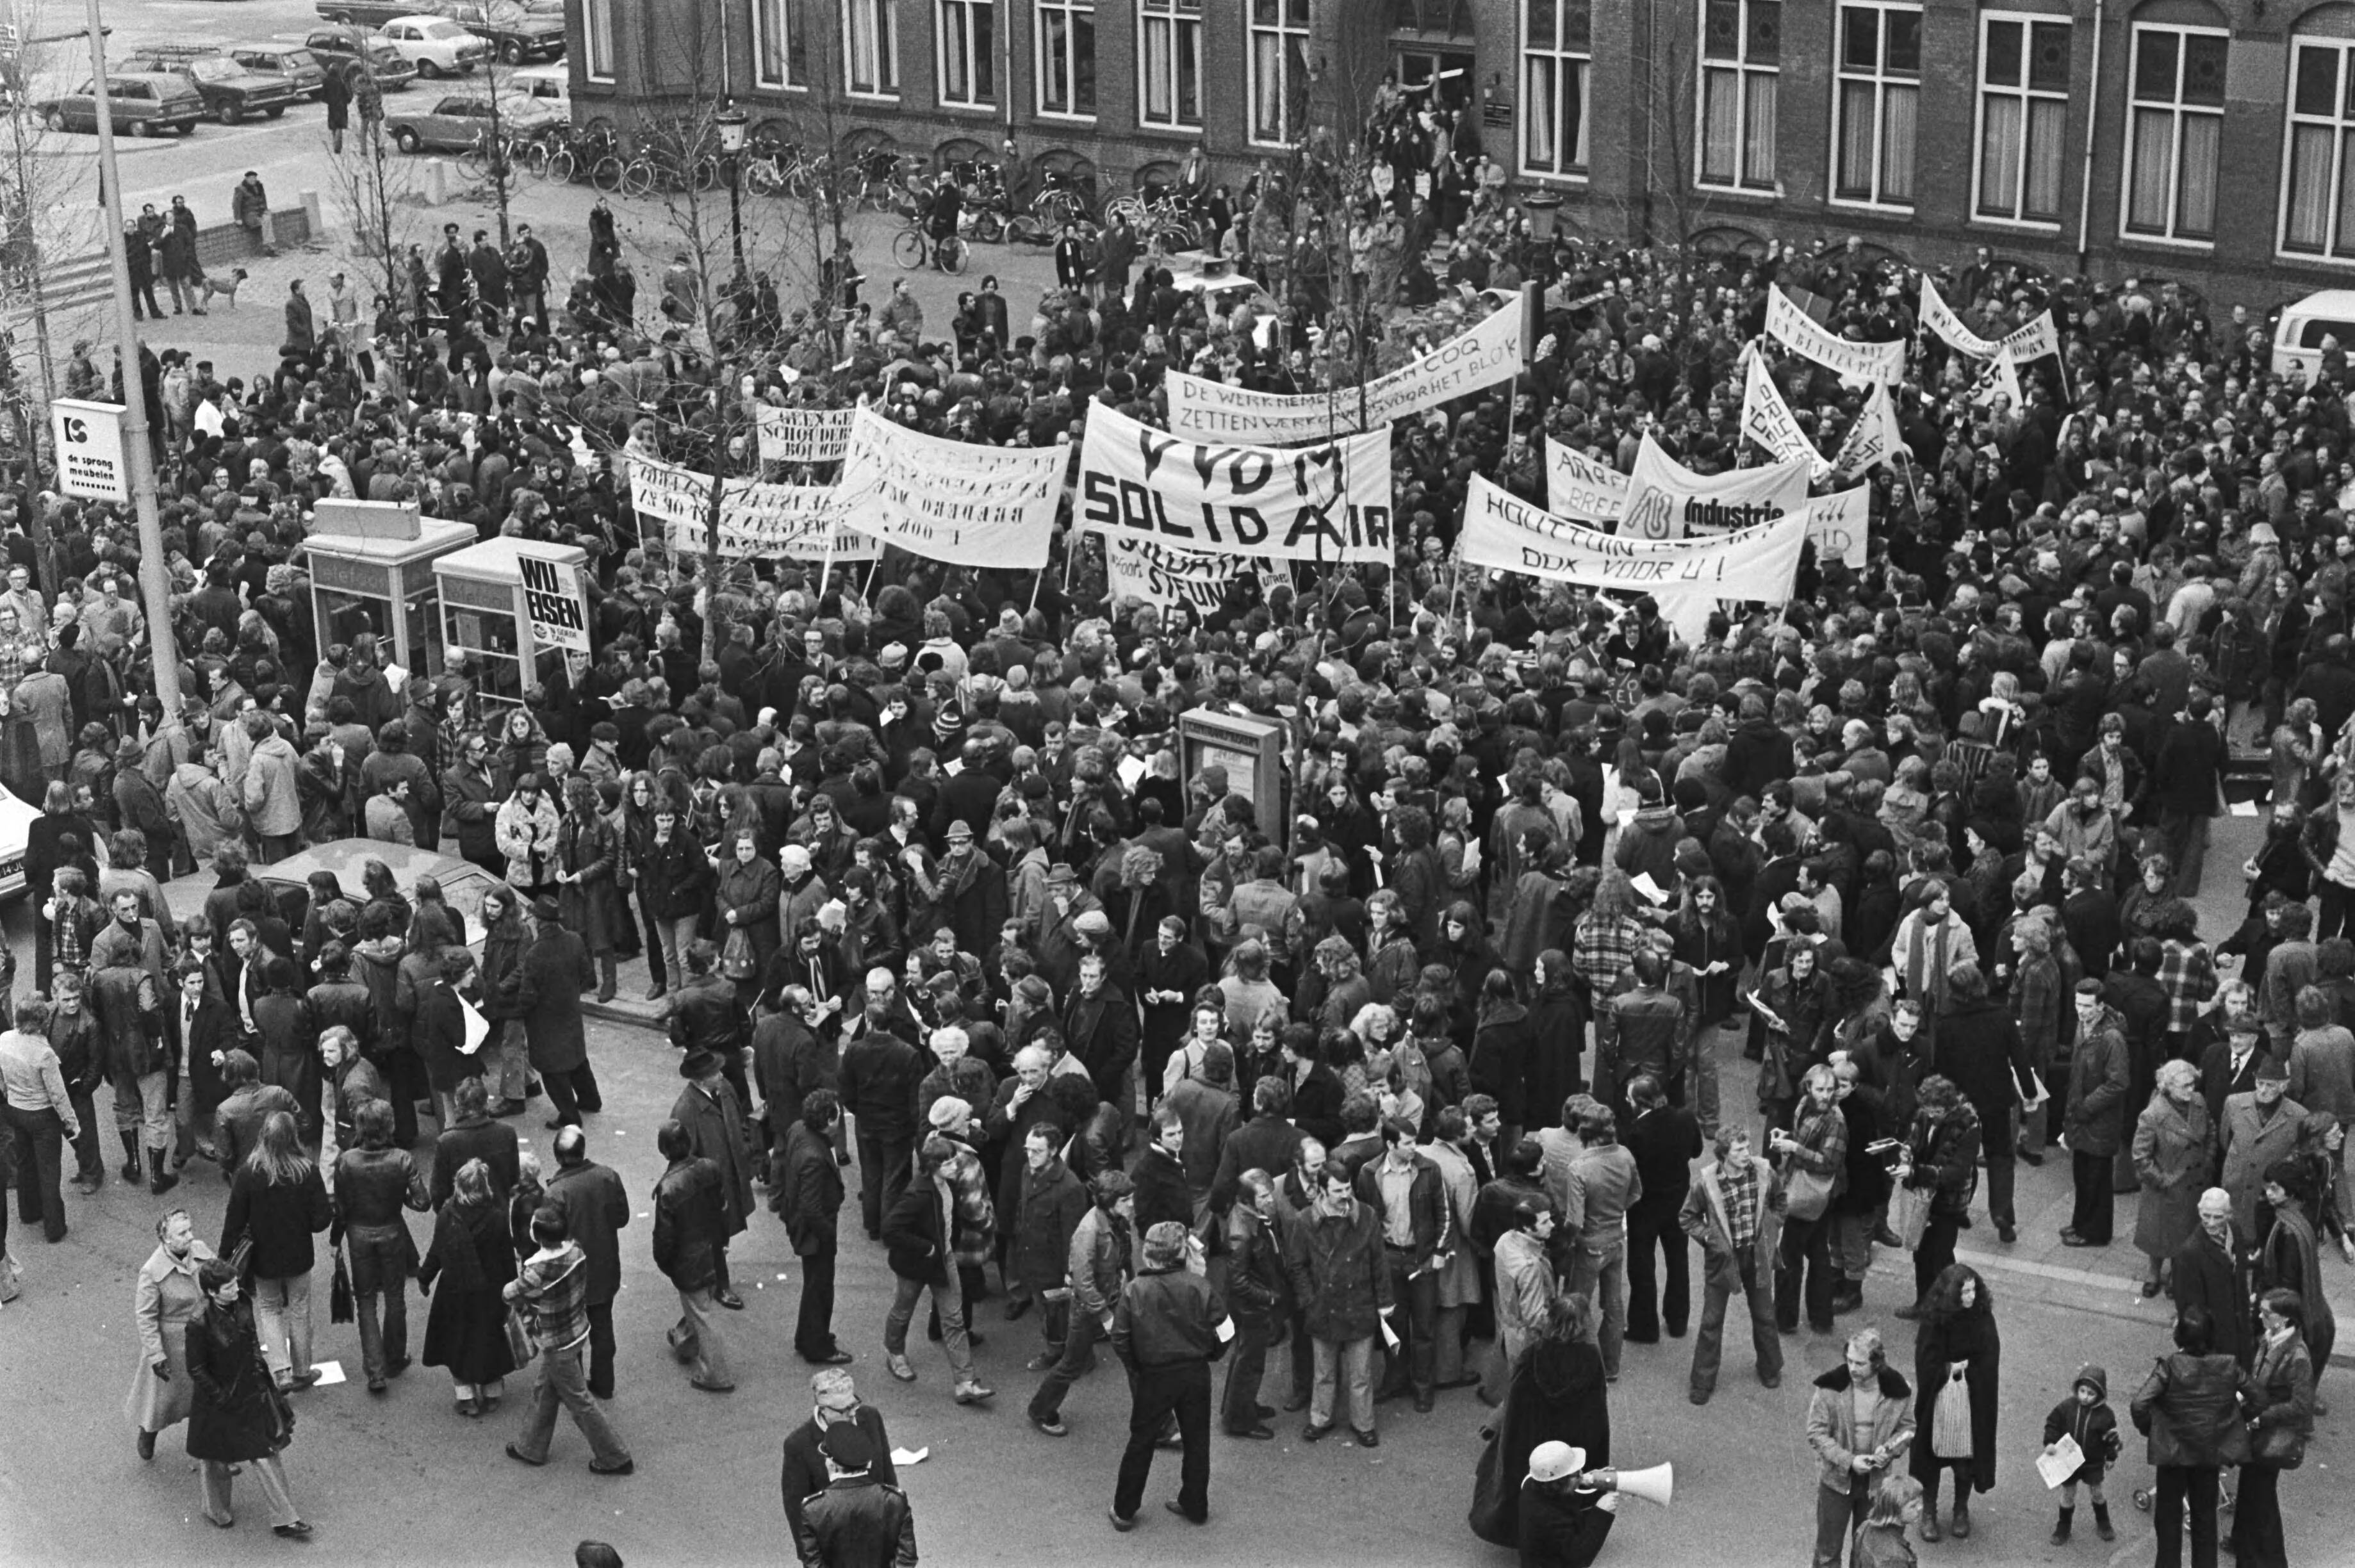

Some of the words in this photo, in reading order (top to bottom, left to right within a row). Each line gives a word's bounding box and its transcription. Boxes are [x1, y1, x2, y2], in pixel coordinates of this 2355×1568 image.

[1180, 407, 1258, 431] ZETTEN
[1430, 369, 1463, 394] HET
[1469, 337, 1518, 377] BLOK
[1183, 380, 1208, 401] DE
[1424, 338, 1481, 373] COQ
[68, 454, 78, 463] de
[82, 457, 113, 471] sprong
[69, 468, 115, 480] meubelen
[1084, 470, 1390, 551] SOLIDAIR
[1486, 492, 1634, 557] HOUTTUIN
[518, 556, 560, 594] WIJ
[1602, 559, 1674, 581] VOOR
[525, 589, 584, 631] EISEN
